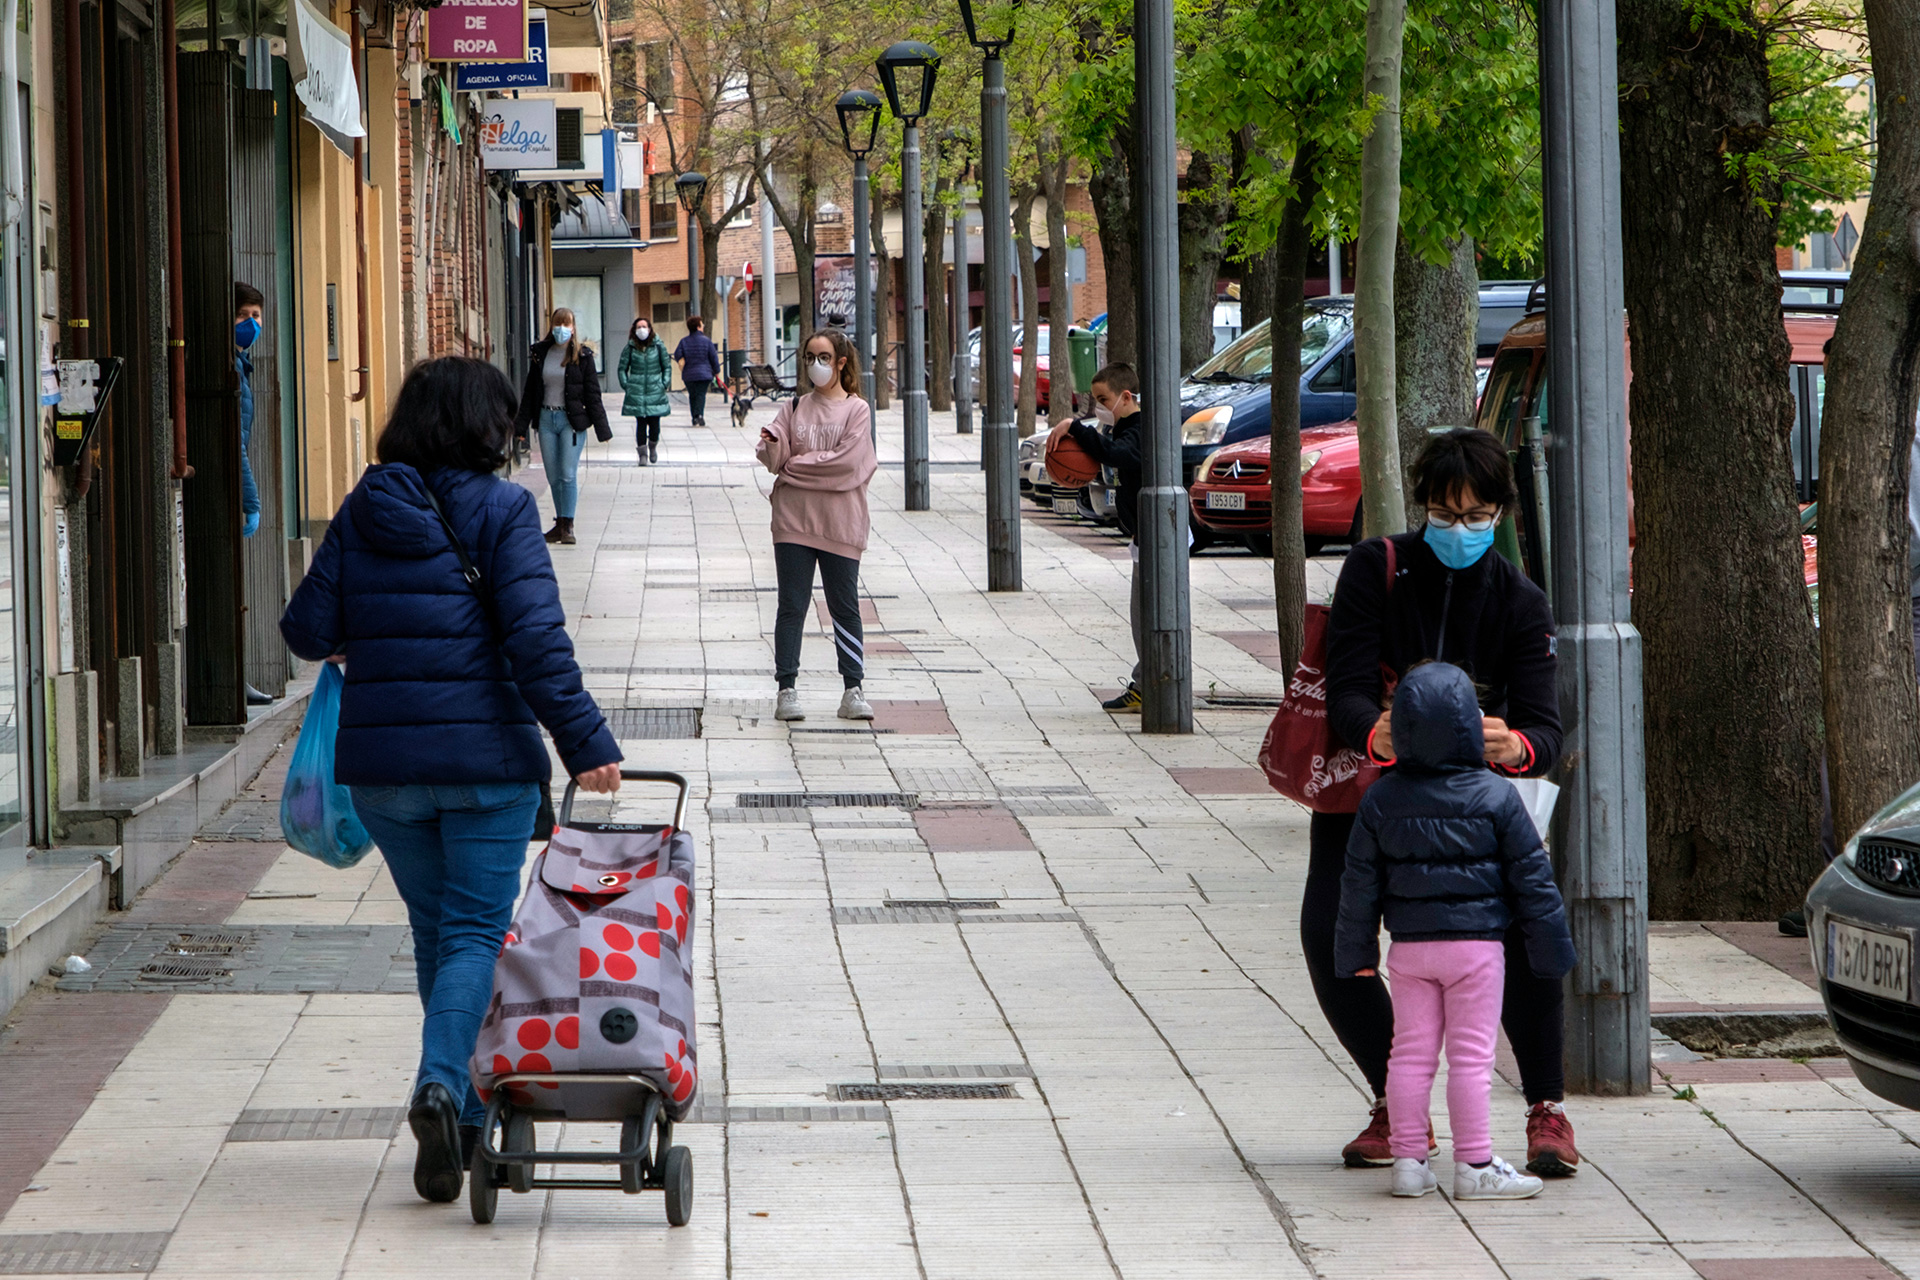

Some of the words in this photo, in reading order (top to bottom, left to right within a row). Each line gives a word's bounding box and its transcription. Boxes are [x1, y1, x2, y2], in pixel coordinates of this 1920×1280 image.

[465, 16, 487, 30] DE
[454, 39, 498, 53] ROPA
[466, 76, 500, 84] AGENCIA
[506, 74, 537, 82] OFICIAL
[1211, 494, 1227, 508] 1953
[1229, 494, 1243, 508] CBY
[1873, 942, 1904, 992] BRX
